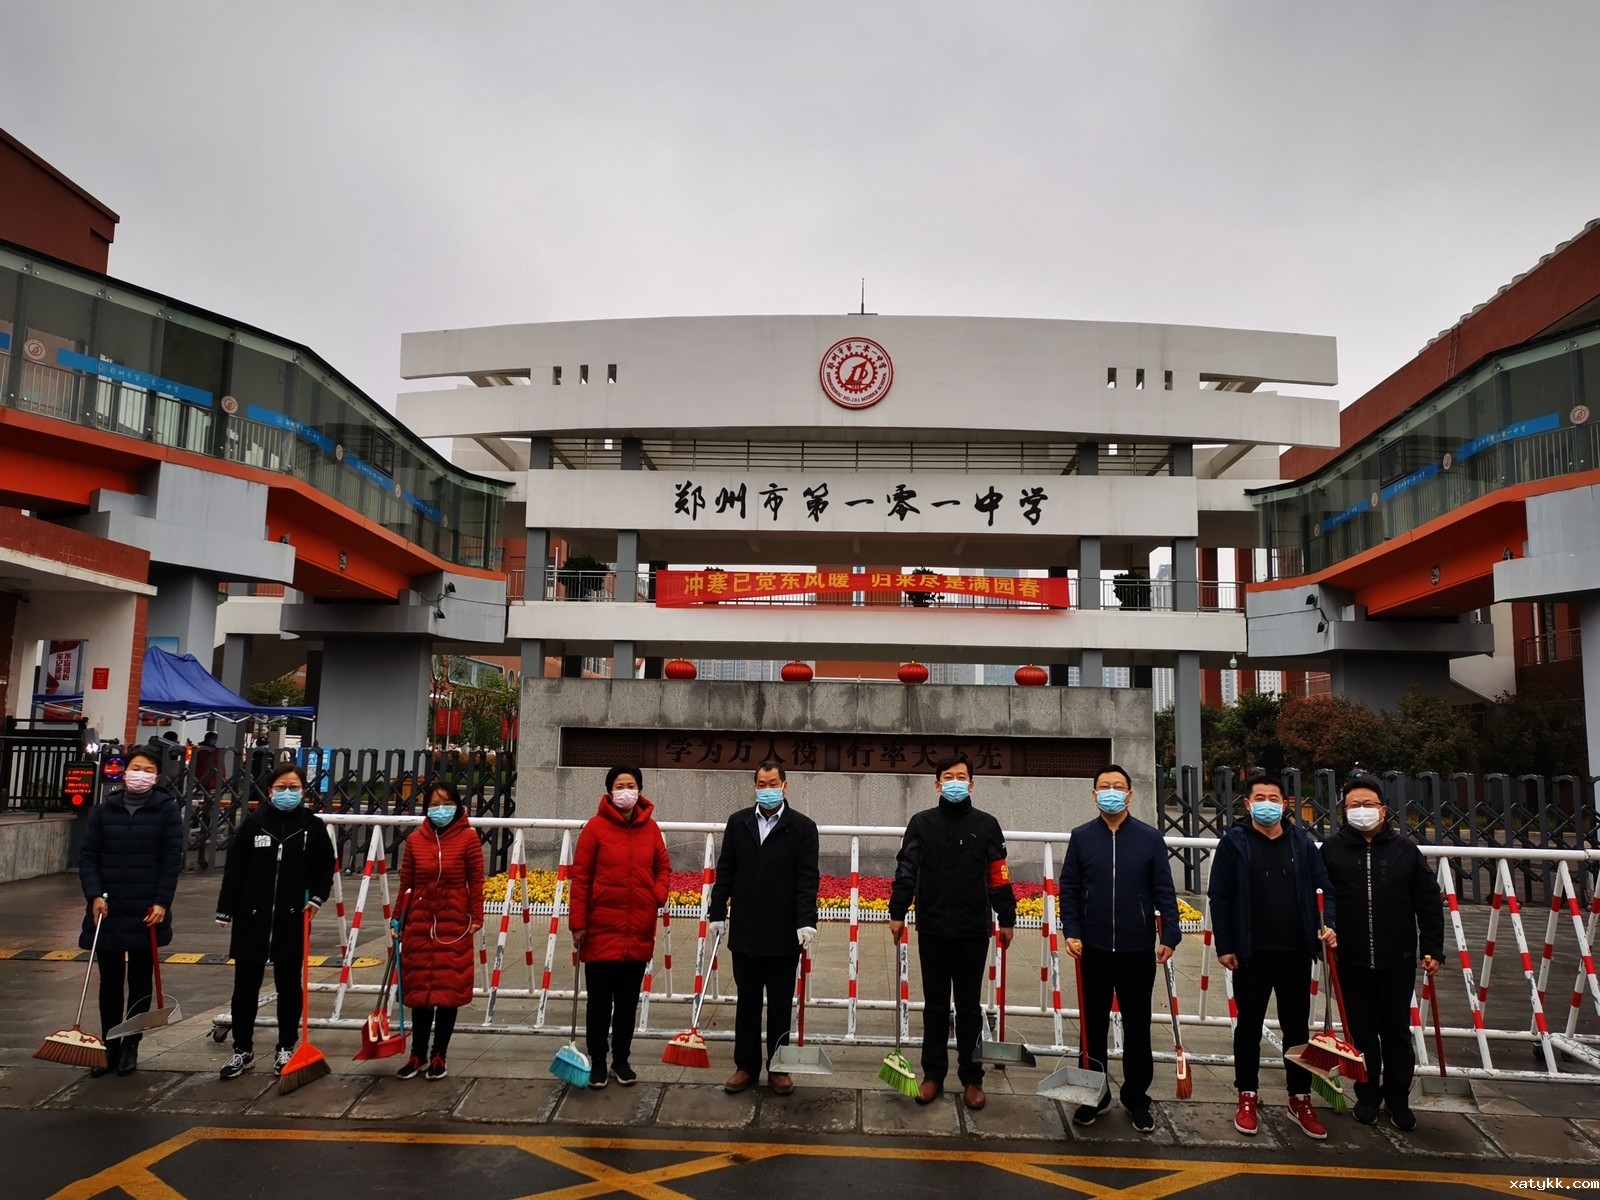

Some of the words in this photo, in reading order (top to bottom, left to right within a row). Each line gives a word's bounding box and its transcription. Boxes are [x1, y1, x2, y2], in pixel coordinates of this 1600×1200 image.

[674, 480, 1049, 527] 郑州市第一零一中学
[684, 572, 850, 597] 冲寒已觉东风暖
[871, 573, 1040, 598] 归来尽是满园春
[665, 735, 818, 767] 学为万人役
